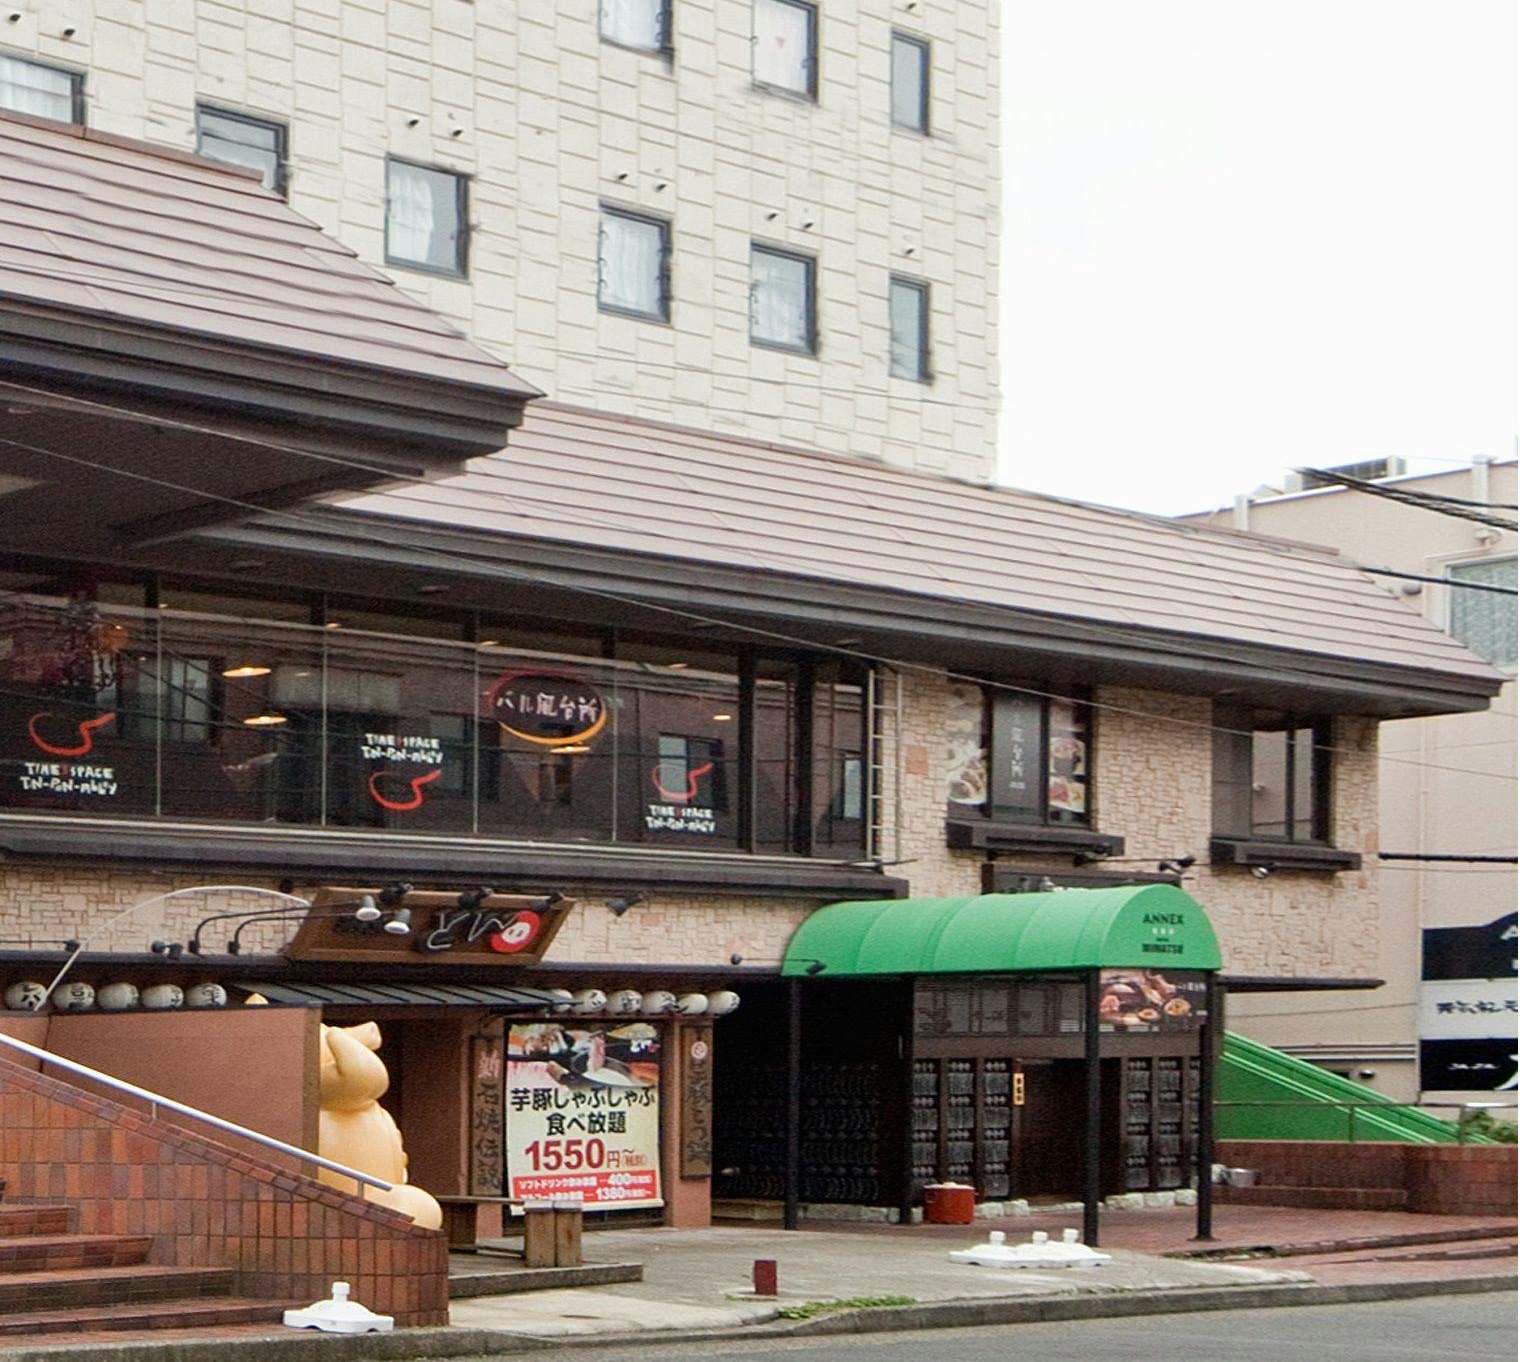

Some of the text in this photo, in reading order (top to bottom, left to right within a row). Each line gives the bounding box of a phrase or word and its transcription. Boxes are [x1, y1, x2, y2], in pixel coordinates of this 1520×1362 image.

[1141, 913, 1183, 925] ANNEX
[510, 1087, 656, 1112] 芋豚しゃぶしゃぶ
[546, 1111, 627, 1136] 食べ放題
